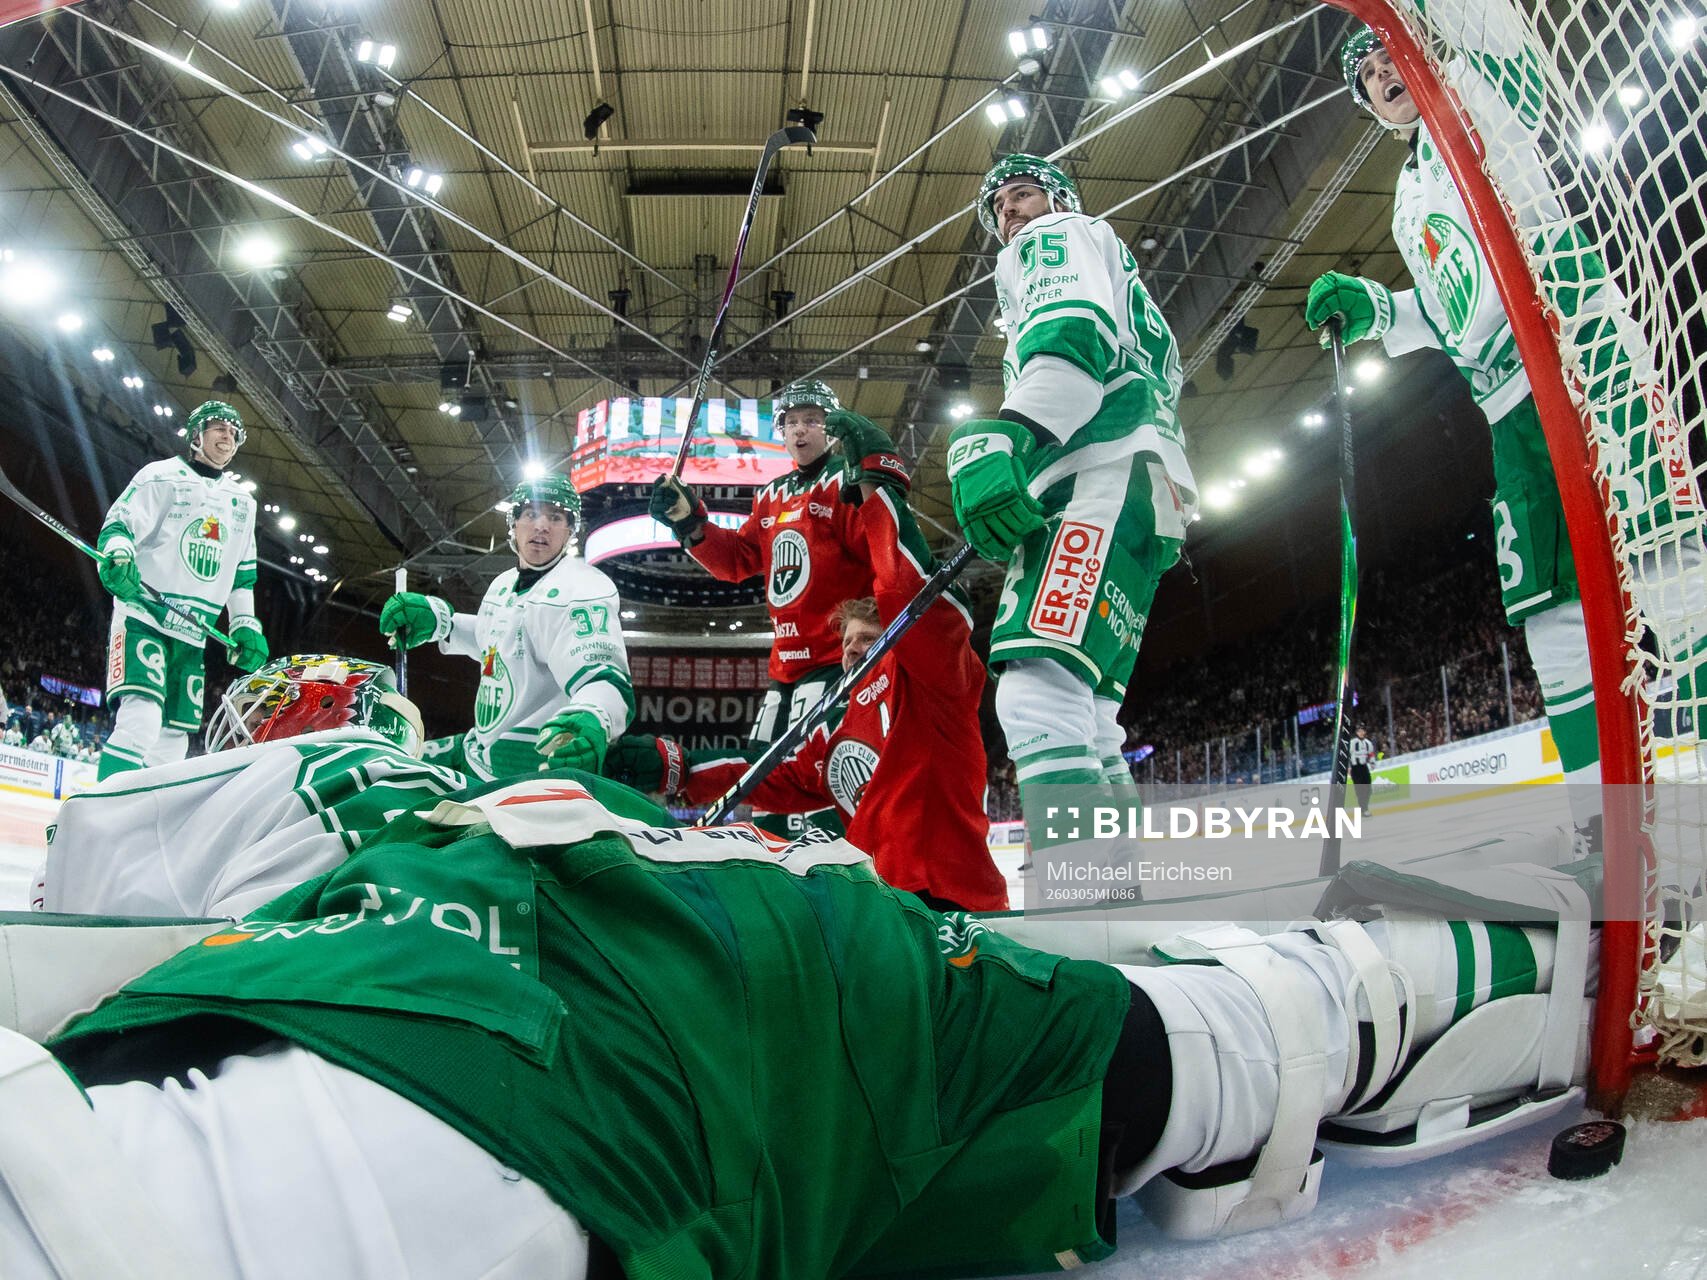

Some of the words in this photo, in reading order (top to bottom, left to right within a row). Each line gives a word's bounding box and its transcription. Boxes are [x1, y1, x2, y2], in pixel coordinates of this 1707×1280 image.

[1025, 288, 1062, 313] CNTER
[1039, 528, 1090, 626] ER-HO
[1073, 557, 1101, 611] BYGG
[571, 605, 608, 636] 37
[640, 696, 764, 723] NORDI
[858, 747, 876, 765] CLUB
